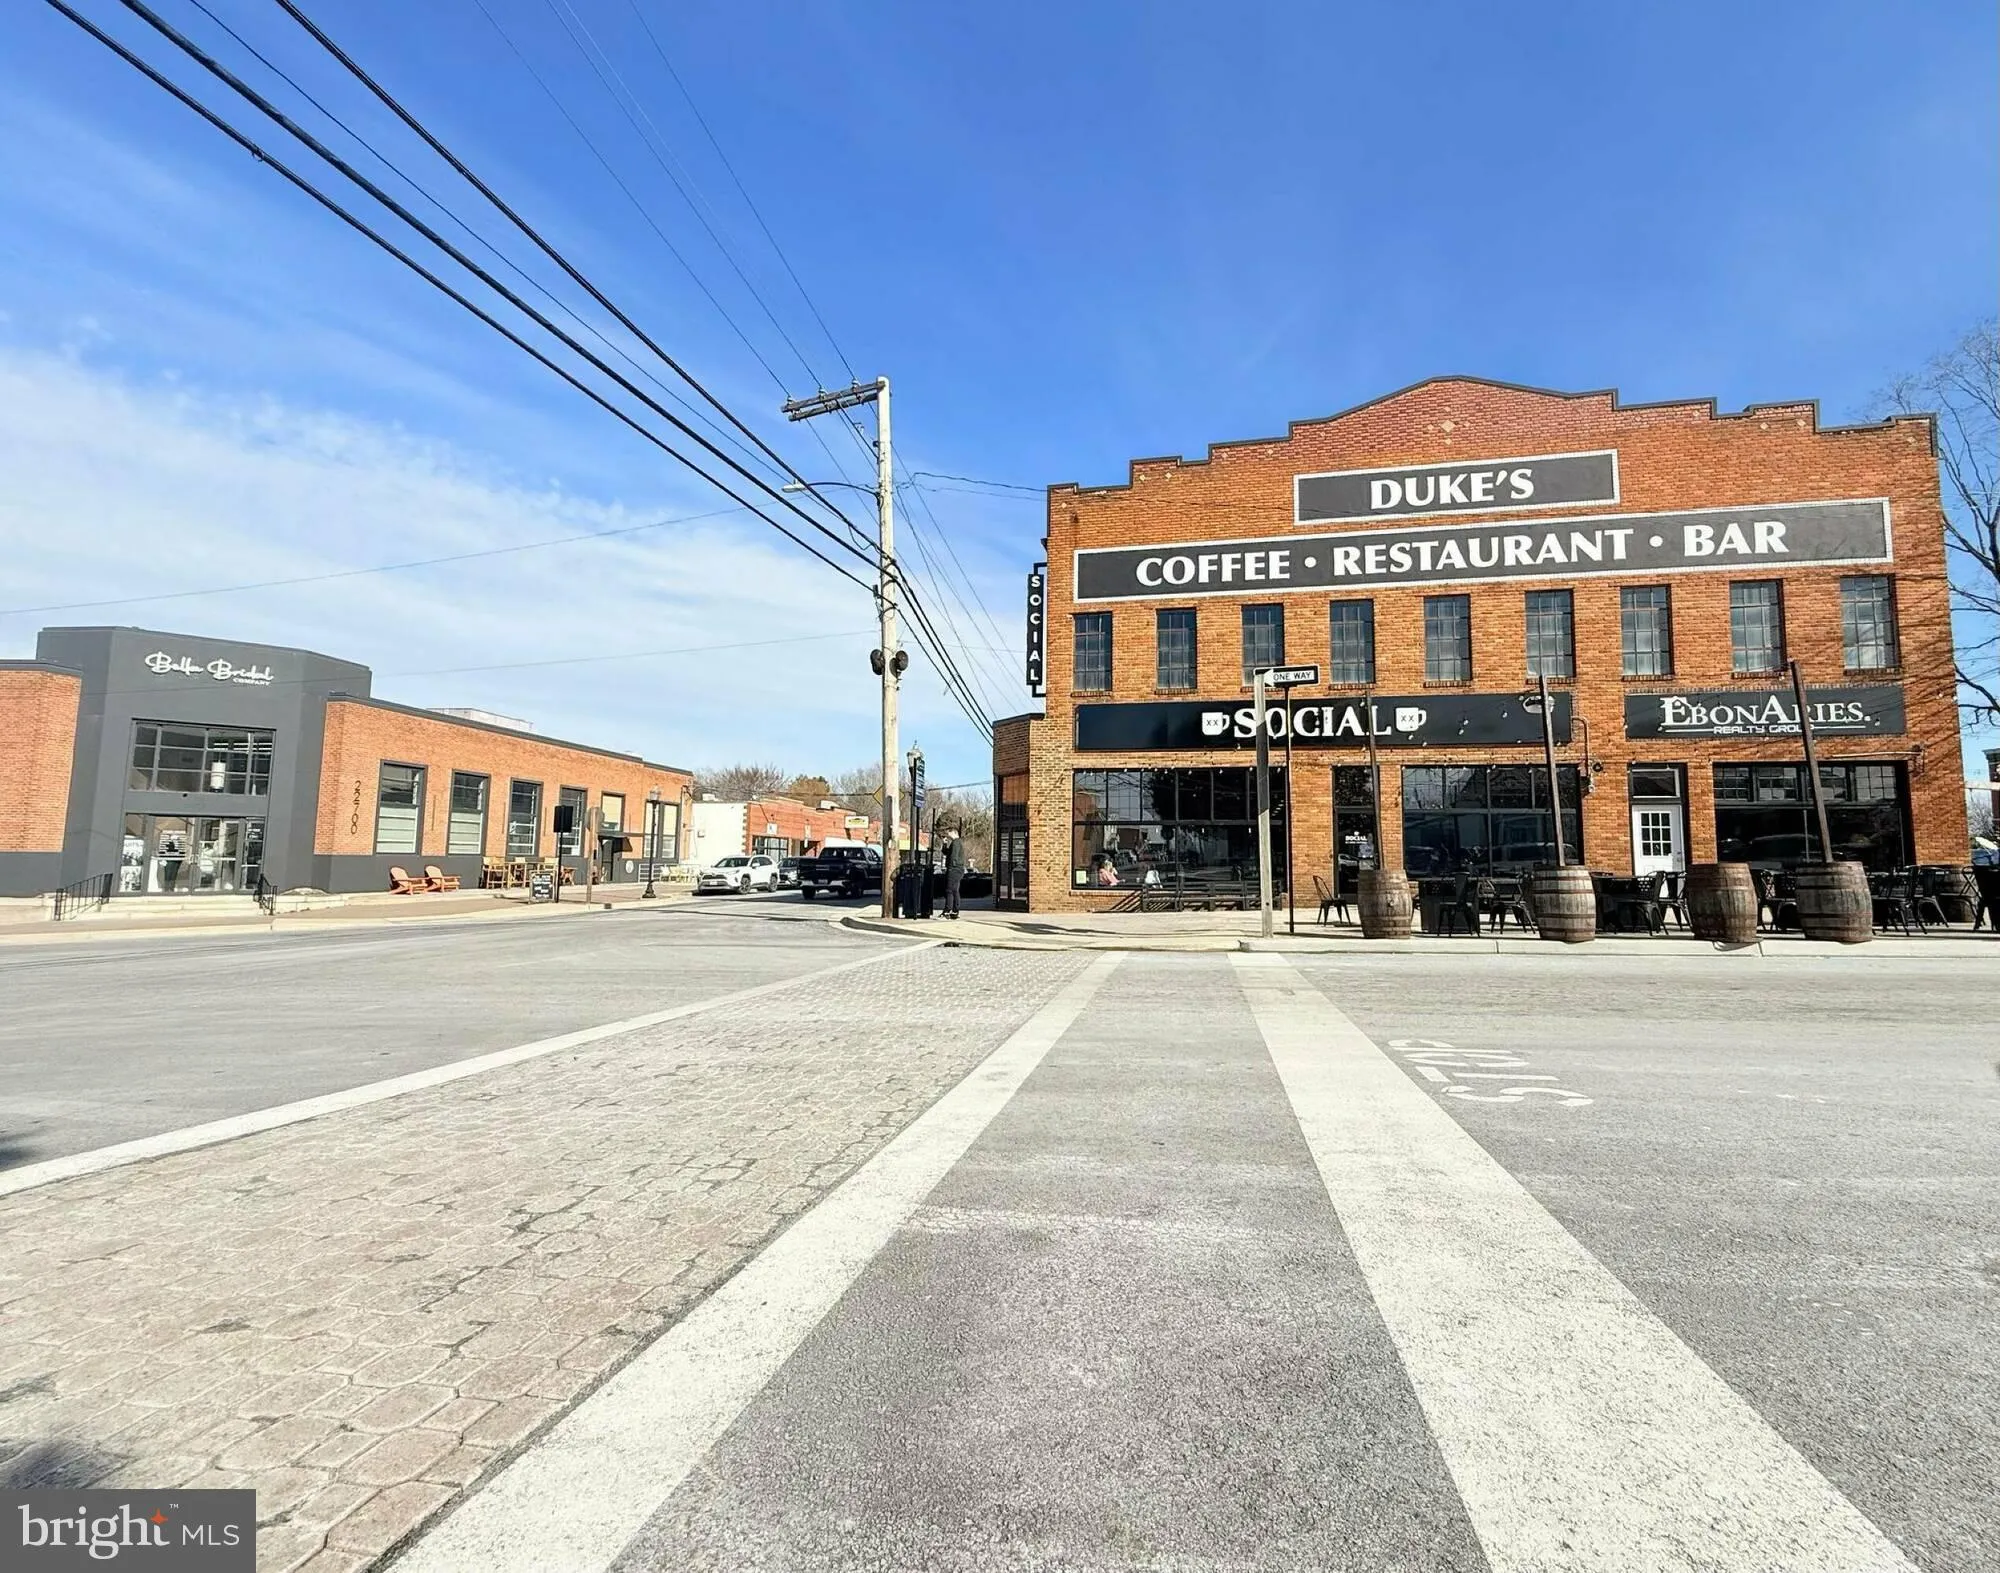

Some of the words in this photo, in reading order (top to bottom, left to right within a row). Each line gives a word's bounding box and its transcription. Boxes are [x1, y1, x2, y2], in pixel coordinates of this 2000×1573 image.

[1370, 468, 1535, 510] DUKE'S
[1135, 550, 1290, 587] COFFEE
[1333, 528, 1634, 576] RESTAURANT
[1683, 521, 1790, 557] BAR
[1030, 575, 1042, 681] SOCIAL
[1273, 673, 1291, 681] ONE
[1293, 671, 1311, 680] WAY
[1233, 705, 1392, 738] SOCIAL
[1713, 725, 1765, 734] REALTY
[1769, 724, 1815, 733] GROU
[351, 780, 361, 835] 22700
